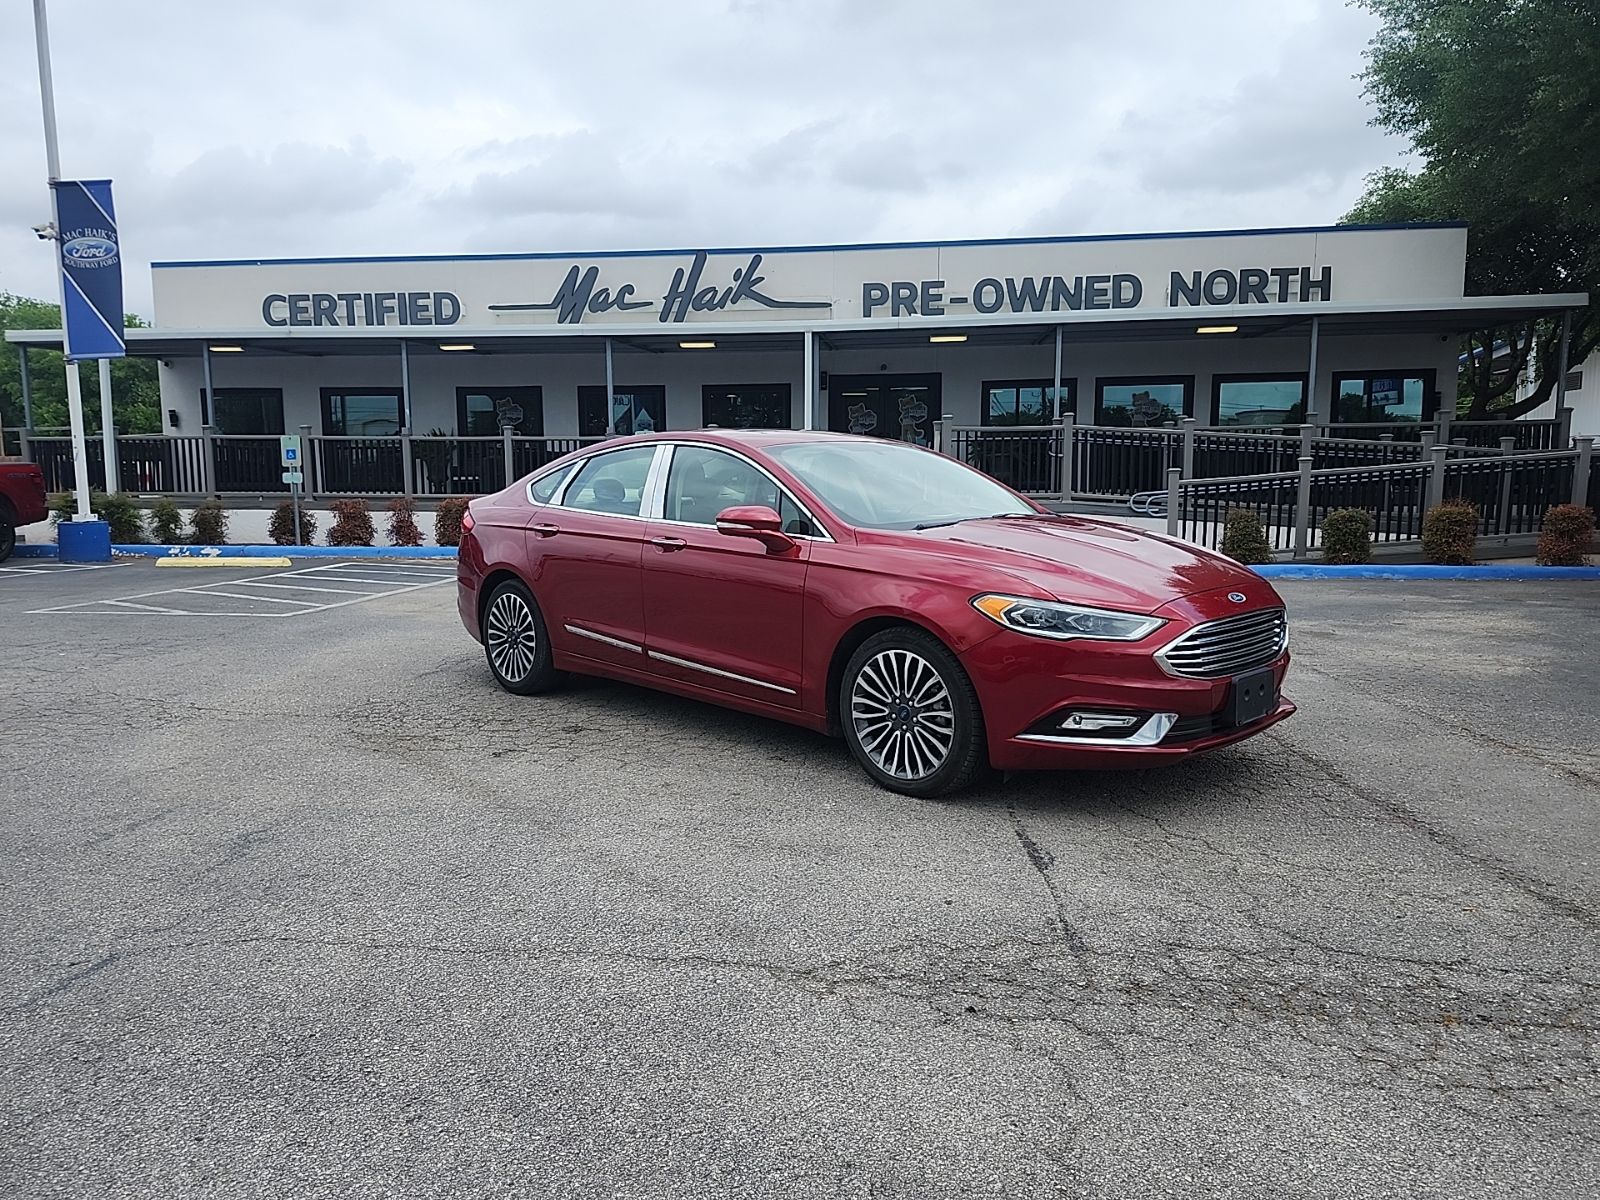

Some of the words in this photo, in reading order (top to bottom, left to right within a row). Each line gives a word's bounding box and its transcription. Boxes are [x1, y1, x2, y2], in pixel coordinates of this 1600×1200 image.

[62, 228, 82, 242] MAC
[84, 228, 117, 242] HAIK'S
[72, 243, 107, 258] Ford
[64, 257, 98, 269] SOUTHWAY
[100, 256, 118, 268] FORD
[262, 291, 462, 327] CERTIFIED
[488, 265, 653, 324] Mac
[658, 250, 832, 323] Haik
[862, 273, 1144, 318] PRE-OWNED
[1169, 265, 1332, 307] NORTH
